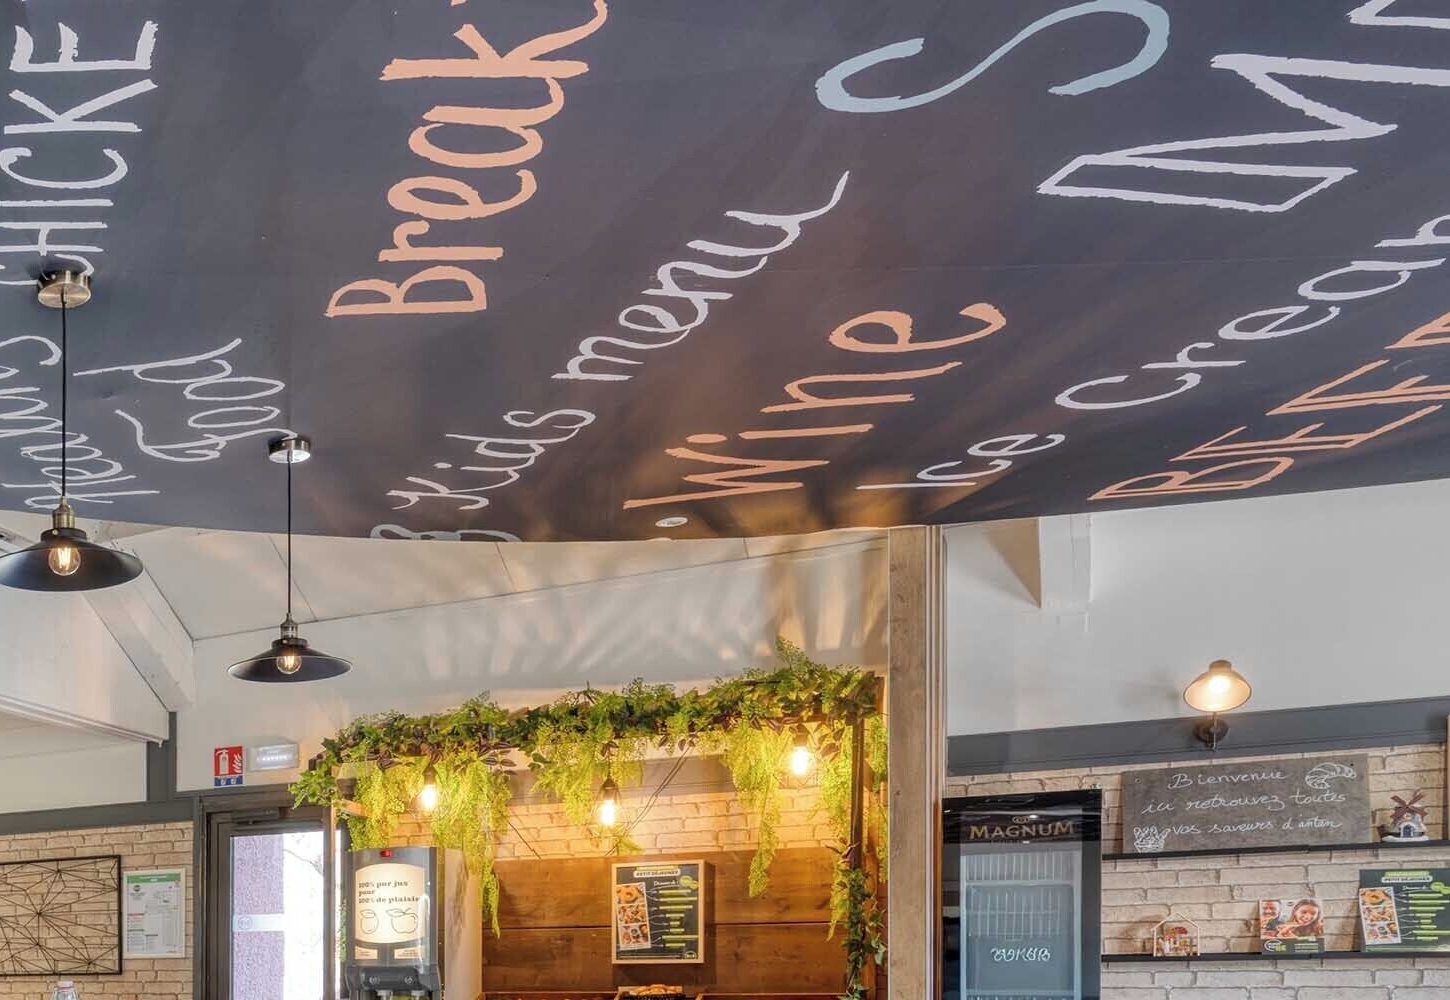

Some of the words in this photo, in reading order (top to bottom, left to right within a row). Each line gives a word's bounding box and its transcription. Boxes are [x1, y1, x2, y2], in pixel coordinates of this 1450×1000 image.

[325, 0, 608, 318] Break
[386, 408, 596, 511] Kids
[552, 170, 849, 381] menu
[73, 338, 298, 463] Food
[623, 302, 1006, 509] Wine
[1087, 310, 1450, 501] BEE
[856, 433, 1065, 490] Ice
[1168, 770, 1286, 790] Bienvenue
[1186, 793, 1286, 811] retrouvez
[1289, 788, 1347, 804] toutes
[969, 821, 1074, 840] MAGNUM
[1208, 821, 1274, 834] saveurs
